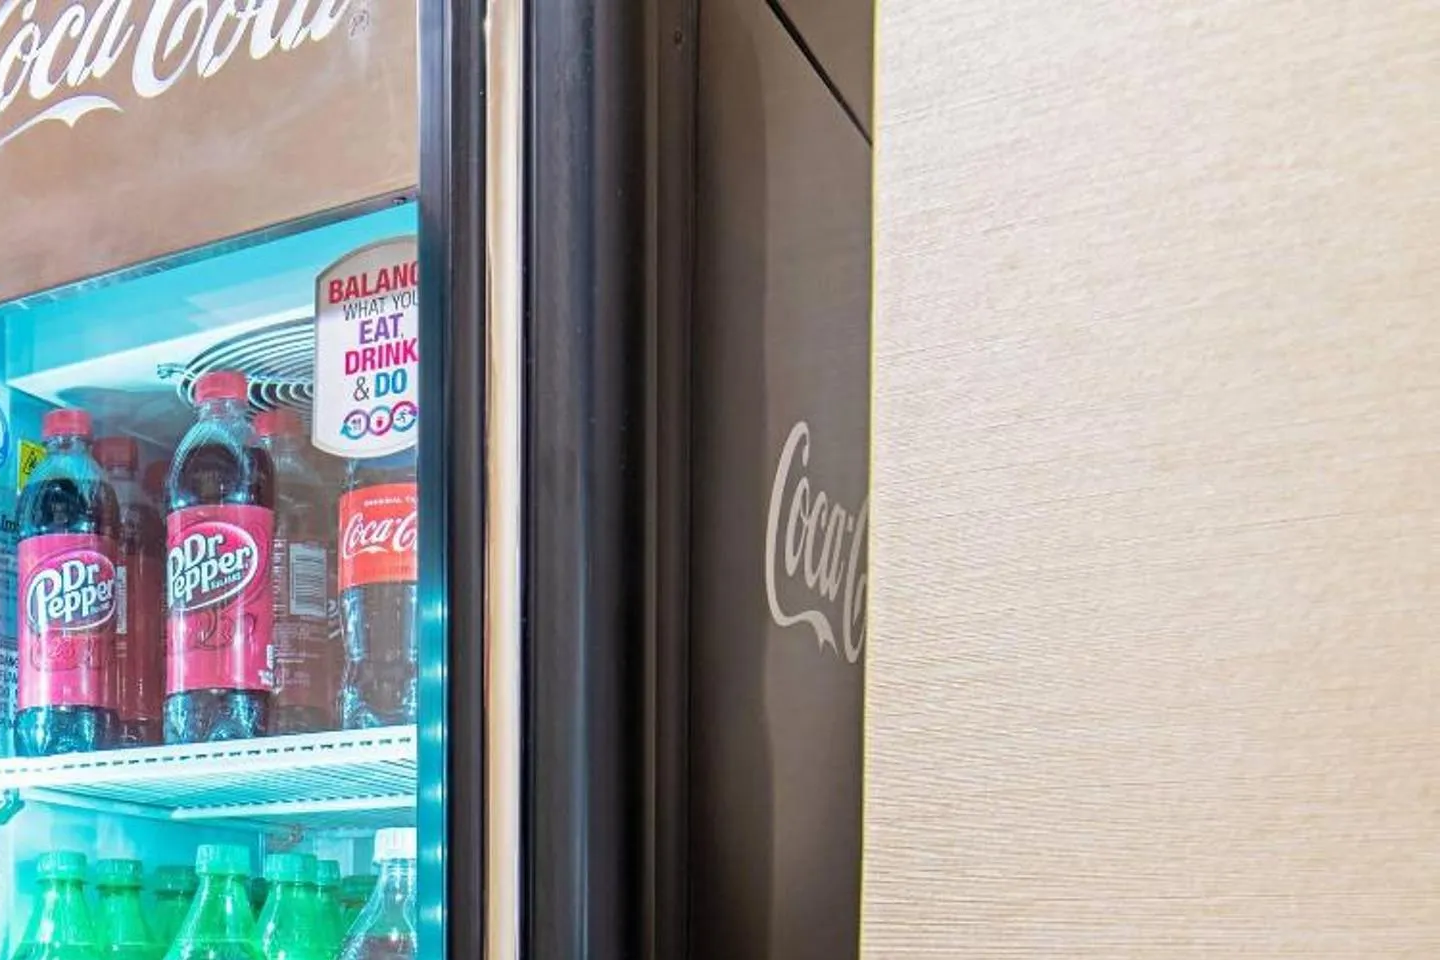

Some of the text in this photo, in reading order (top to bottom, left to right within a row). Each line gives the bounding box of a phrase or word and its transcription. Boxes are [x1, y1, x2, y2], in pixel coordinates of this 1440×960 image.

[343, 296, 385, 321] WHAT
[353, 367, 408, 402] & DO
[184, 534, 224, 566] Dr
[62, 559, 100, 591] Dr
[167, 546, 251, 608] Pepper
[27, 568, 114, 634] Pepper
